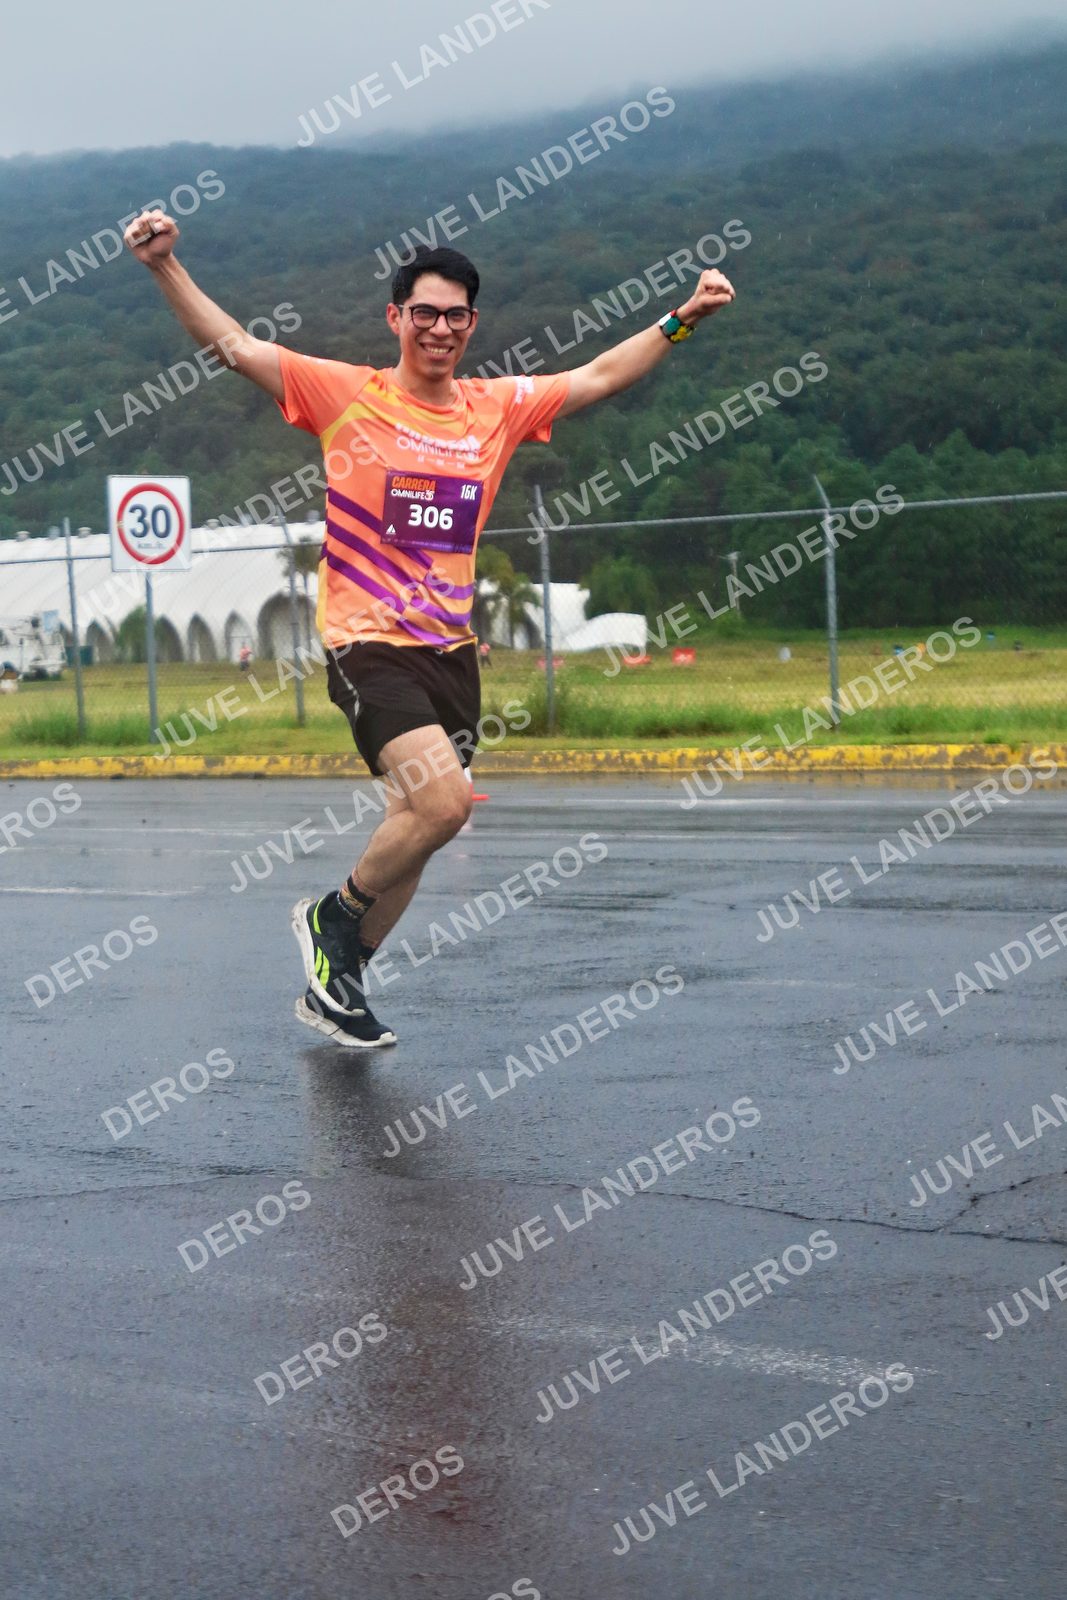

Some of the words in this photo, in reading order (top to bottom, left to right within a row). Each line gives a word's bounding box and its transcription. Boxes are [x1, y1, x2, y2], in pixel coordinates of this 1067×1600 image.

[391, 475, 437, 491] CARRERA
[129, 503, 172, 539] 30
[407, 503, 454, 531] 306
